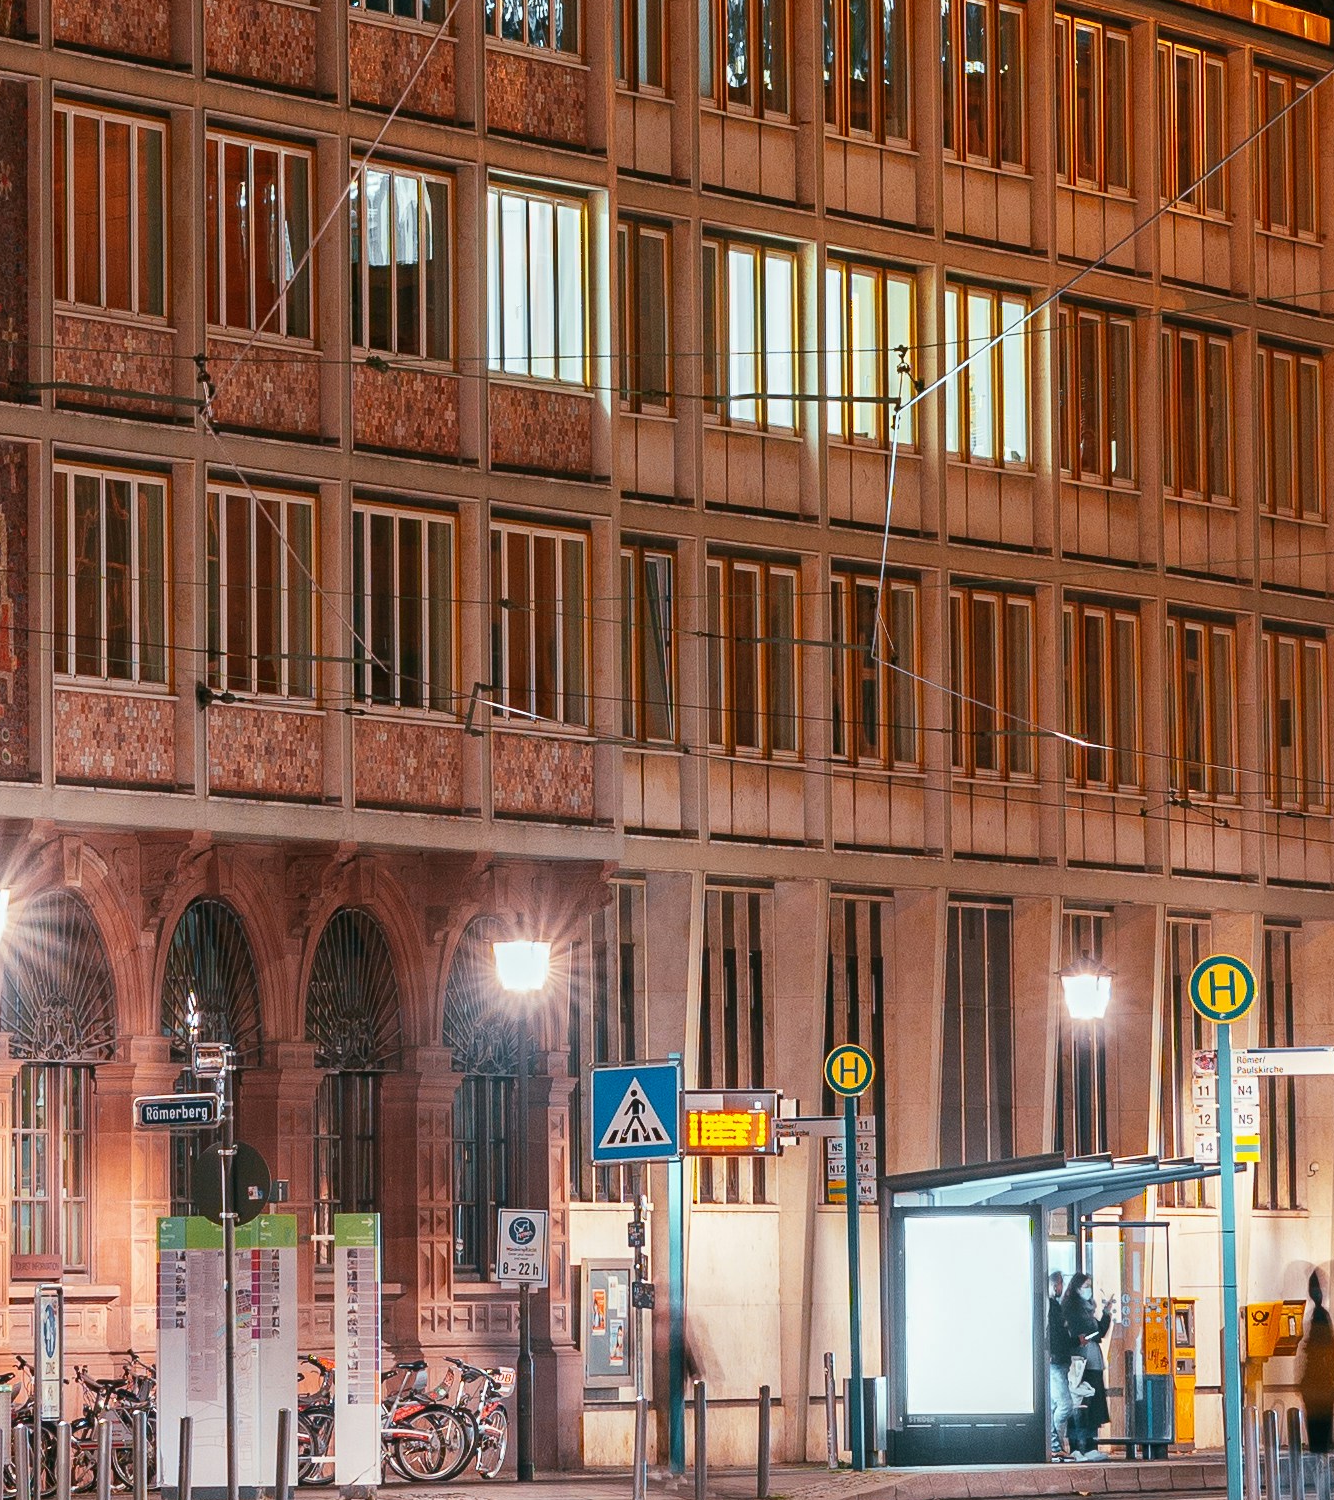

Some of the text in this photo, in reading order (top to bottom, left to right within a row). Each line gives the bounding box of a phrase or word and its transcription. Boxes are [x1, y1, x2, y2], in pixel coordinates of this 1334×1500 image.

[1209, 970, 1236, 1006] H
[1236, 1055, 1266, 1064] Römer/
[840, 1056, 859, 1084] H
[1236, 1065, 1284, 1074] Paulskirche
[1197, 1085, 1210, 1096] 11
[1238, 1085, 1253, 1096] N4
[146, 1105, 209, 1122] Römerberg
[1198, 1113, 1211, 1125] 12
[1238, 1113, 1254, 1125] N5
[858, 1120, 869, 1130] 11
[859, 1142, 870, 1151] 12
[1200, 1142, 1214, 1154] 14
[829, 1164, 846, 1173] N12
[859, 1163, 870, 1172] 14
[860, 1185, 872, 1194] N4
[503, 1262, 509, 1275] 8
[518, 1262, 530, 1275] 22
[533, 1263, 539, 1276] h
